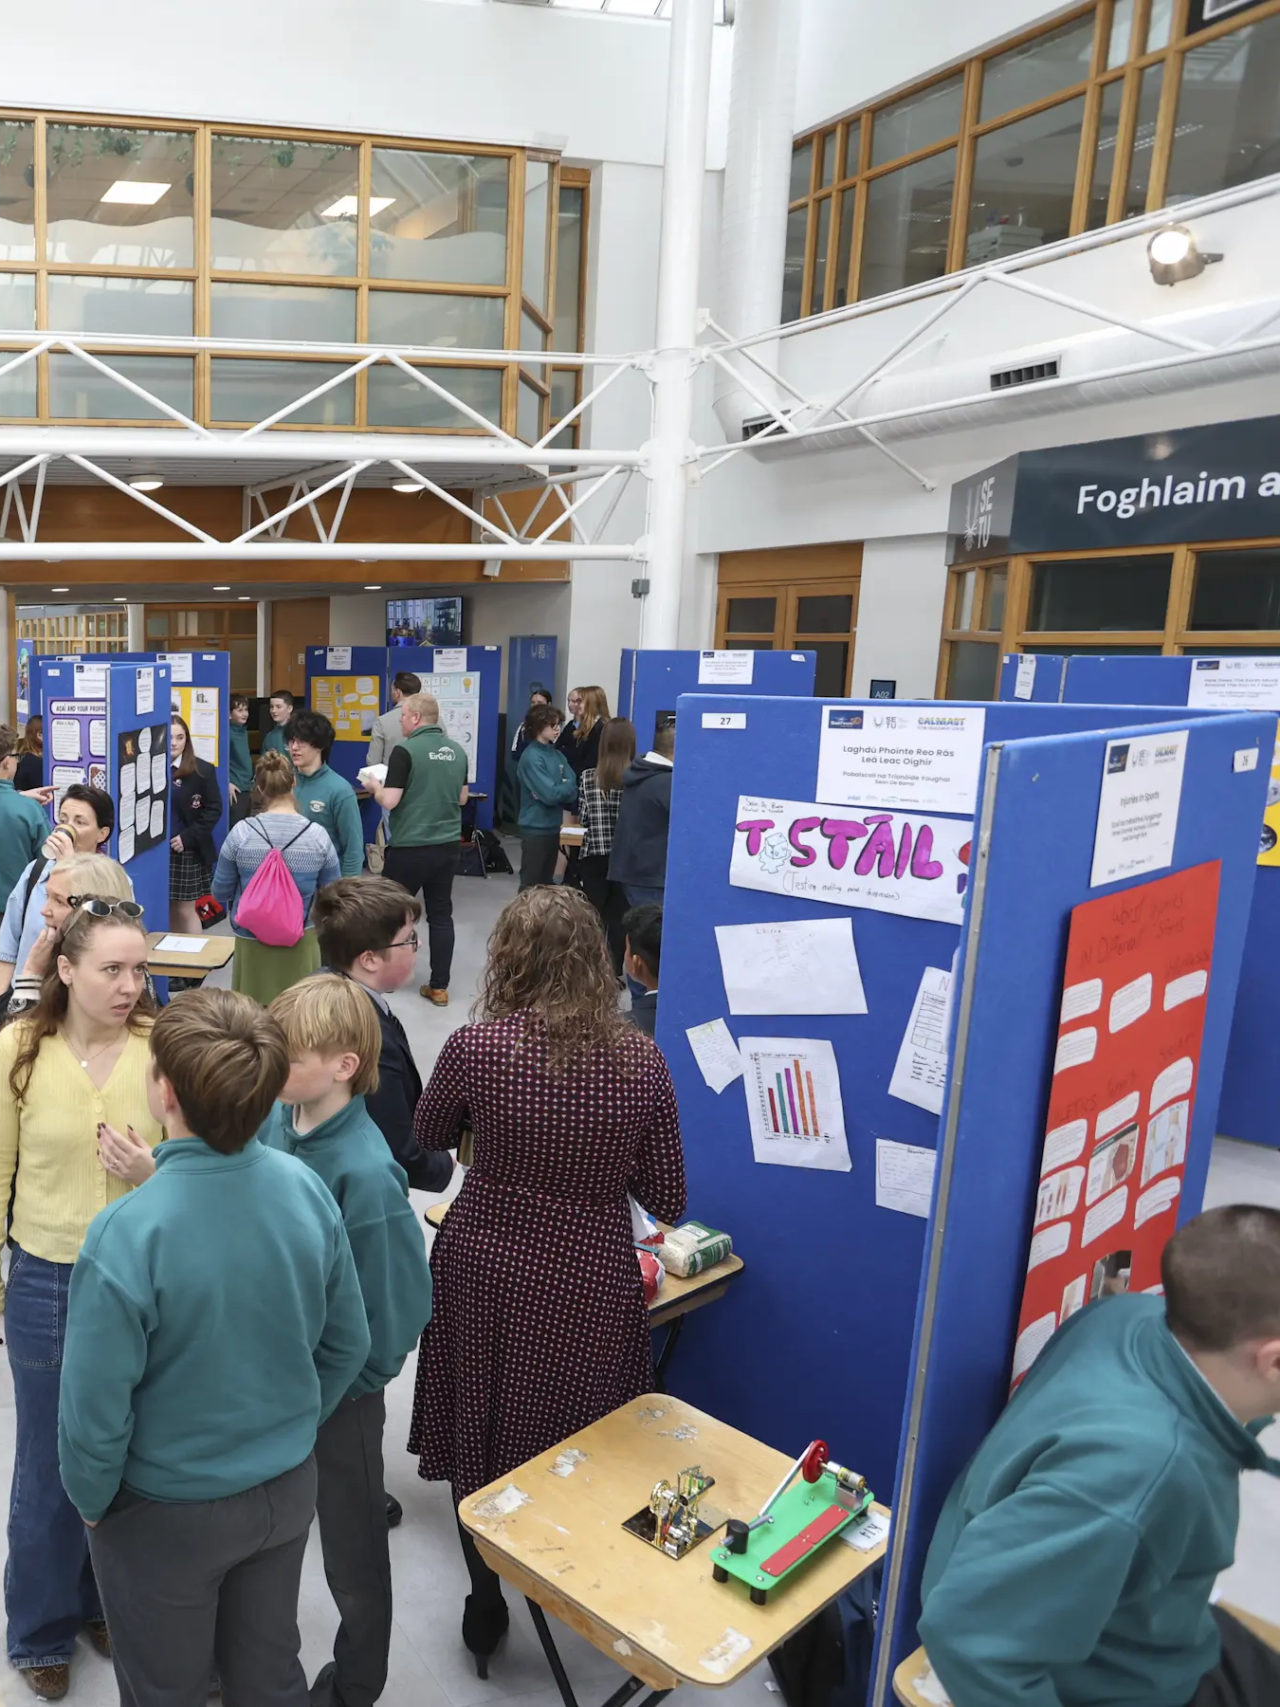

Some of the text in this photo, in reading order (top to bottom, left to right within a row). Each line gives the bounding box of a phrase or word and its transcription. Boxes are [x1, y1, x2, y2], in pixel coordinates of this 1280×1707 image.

[980, 477, 995, 512] SE
[1077, 470, 1245, 519] Foghlaim
[977, 514, 991, 549] TU
[875, 691, 890, 699] A02
[720, 717, 732, 725] 27
[917, 717, 966, 726] CALMAST
[843, 745, 877, 755] Laghdú
[879, 746, 914, 756] Phointe
[429, 752, 453, 761] EirGrid
[879, 757, 901, 765] Leac
[903, 758, 932, 767] Oighir
[843, 771, 876, 779] Pobalscoil
[921, 775, 951, 784] Youghal
[1144, 791, 1160, 804] Sports
